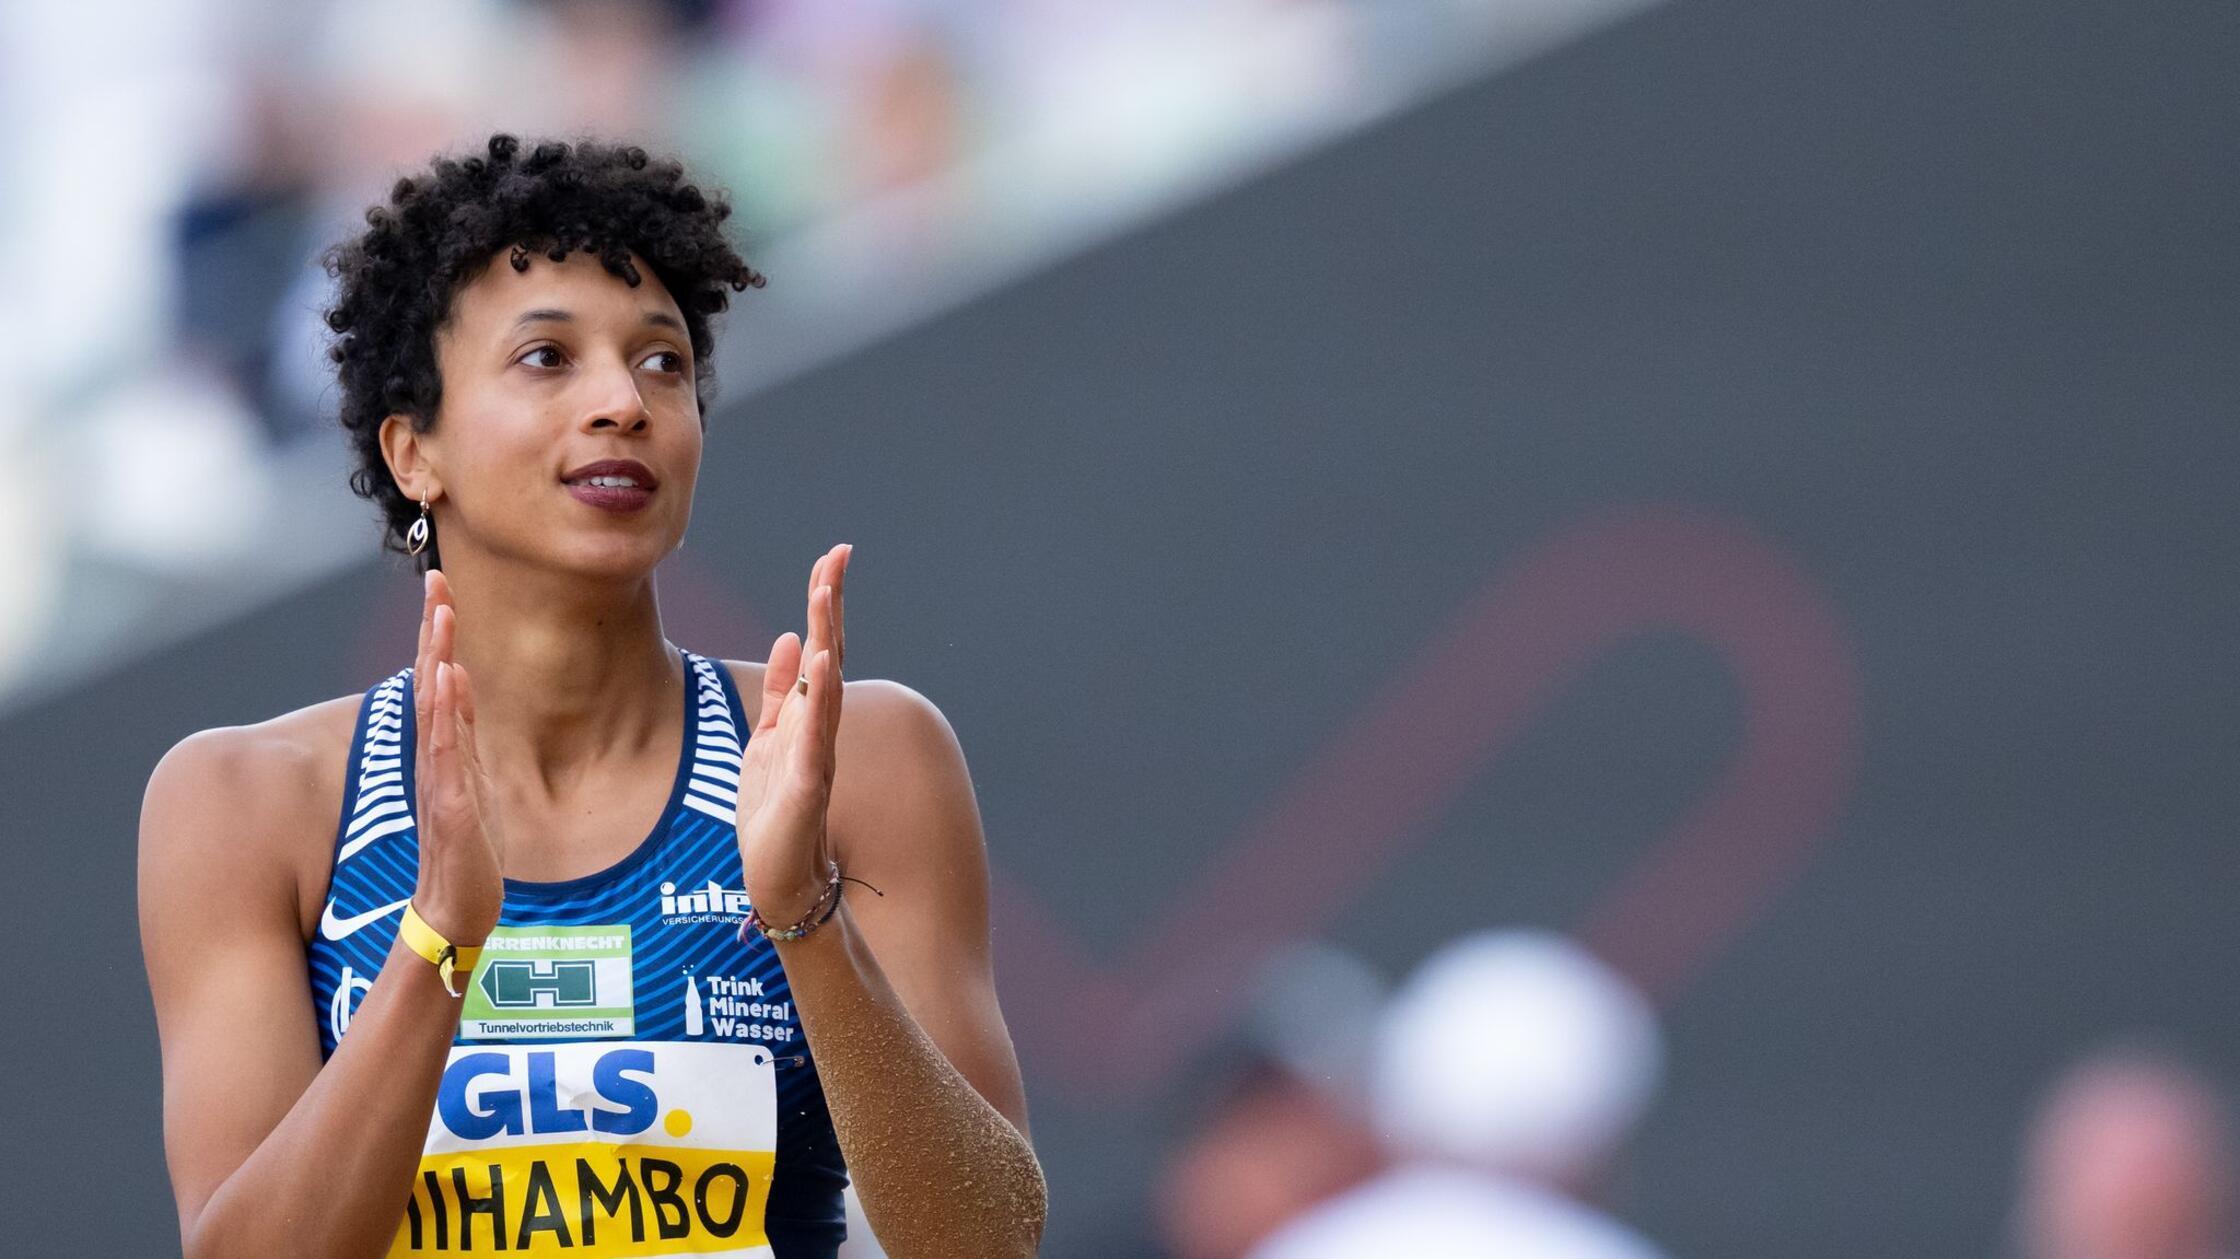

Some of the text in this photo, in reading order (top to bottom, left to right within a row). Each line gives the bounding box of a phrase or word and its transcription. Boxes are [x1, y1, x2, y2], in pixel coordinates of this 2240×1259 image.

[706, 975, 765, 996] Trink
[709, 996, 789, 1021] Mineral
[478, 1021, 615, 1034] Tunnelvortriebstechnik
[711, 1017, 794, 1042] Wasser
[407, 1157, 750, 1251] IHAMBO
